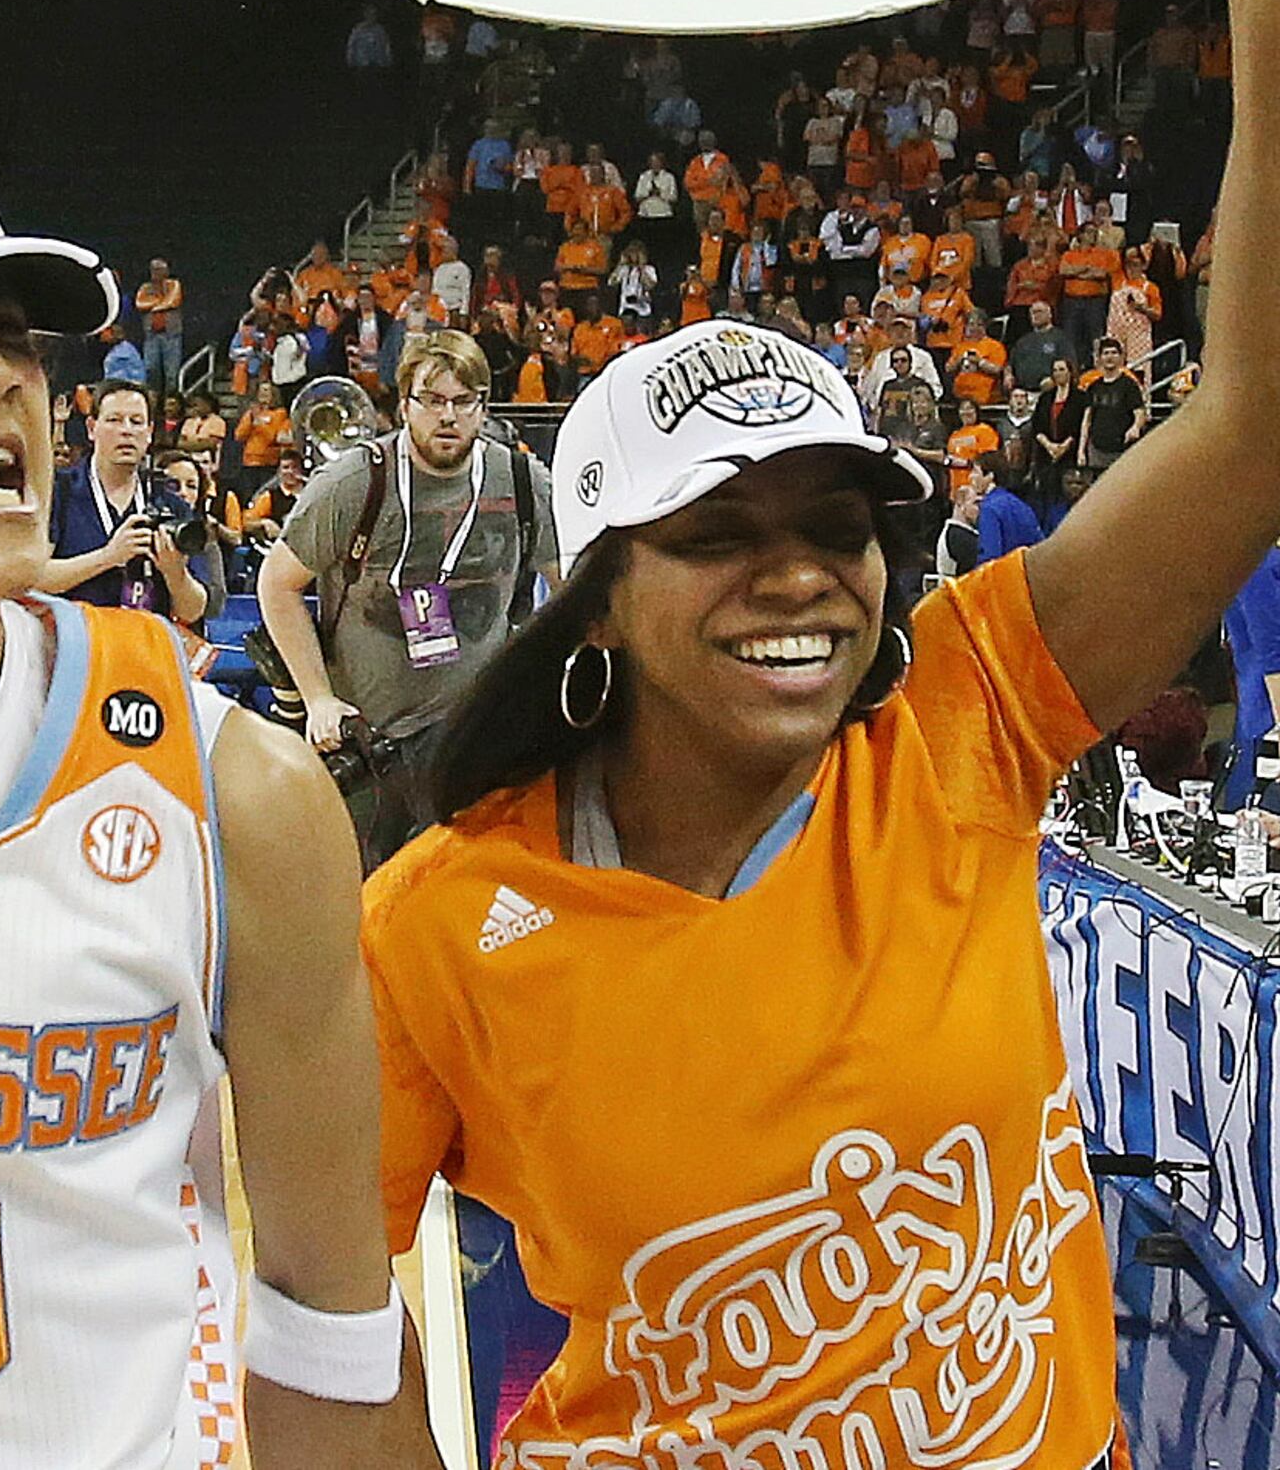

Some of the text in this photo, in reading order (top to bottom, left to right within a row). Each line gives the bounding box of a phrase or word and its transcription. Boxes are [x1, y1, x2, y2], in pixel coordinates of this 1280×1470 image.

[412, 589, 431, 623] P
[89, 807, 157, 878] SEC
[478, 906, 555, 954] adidas
